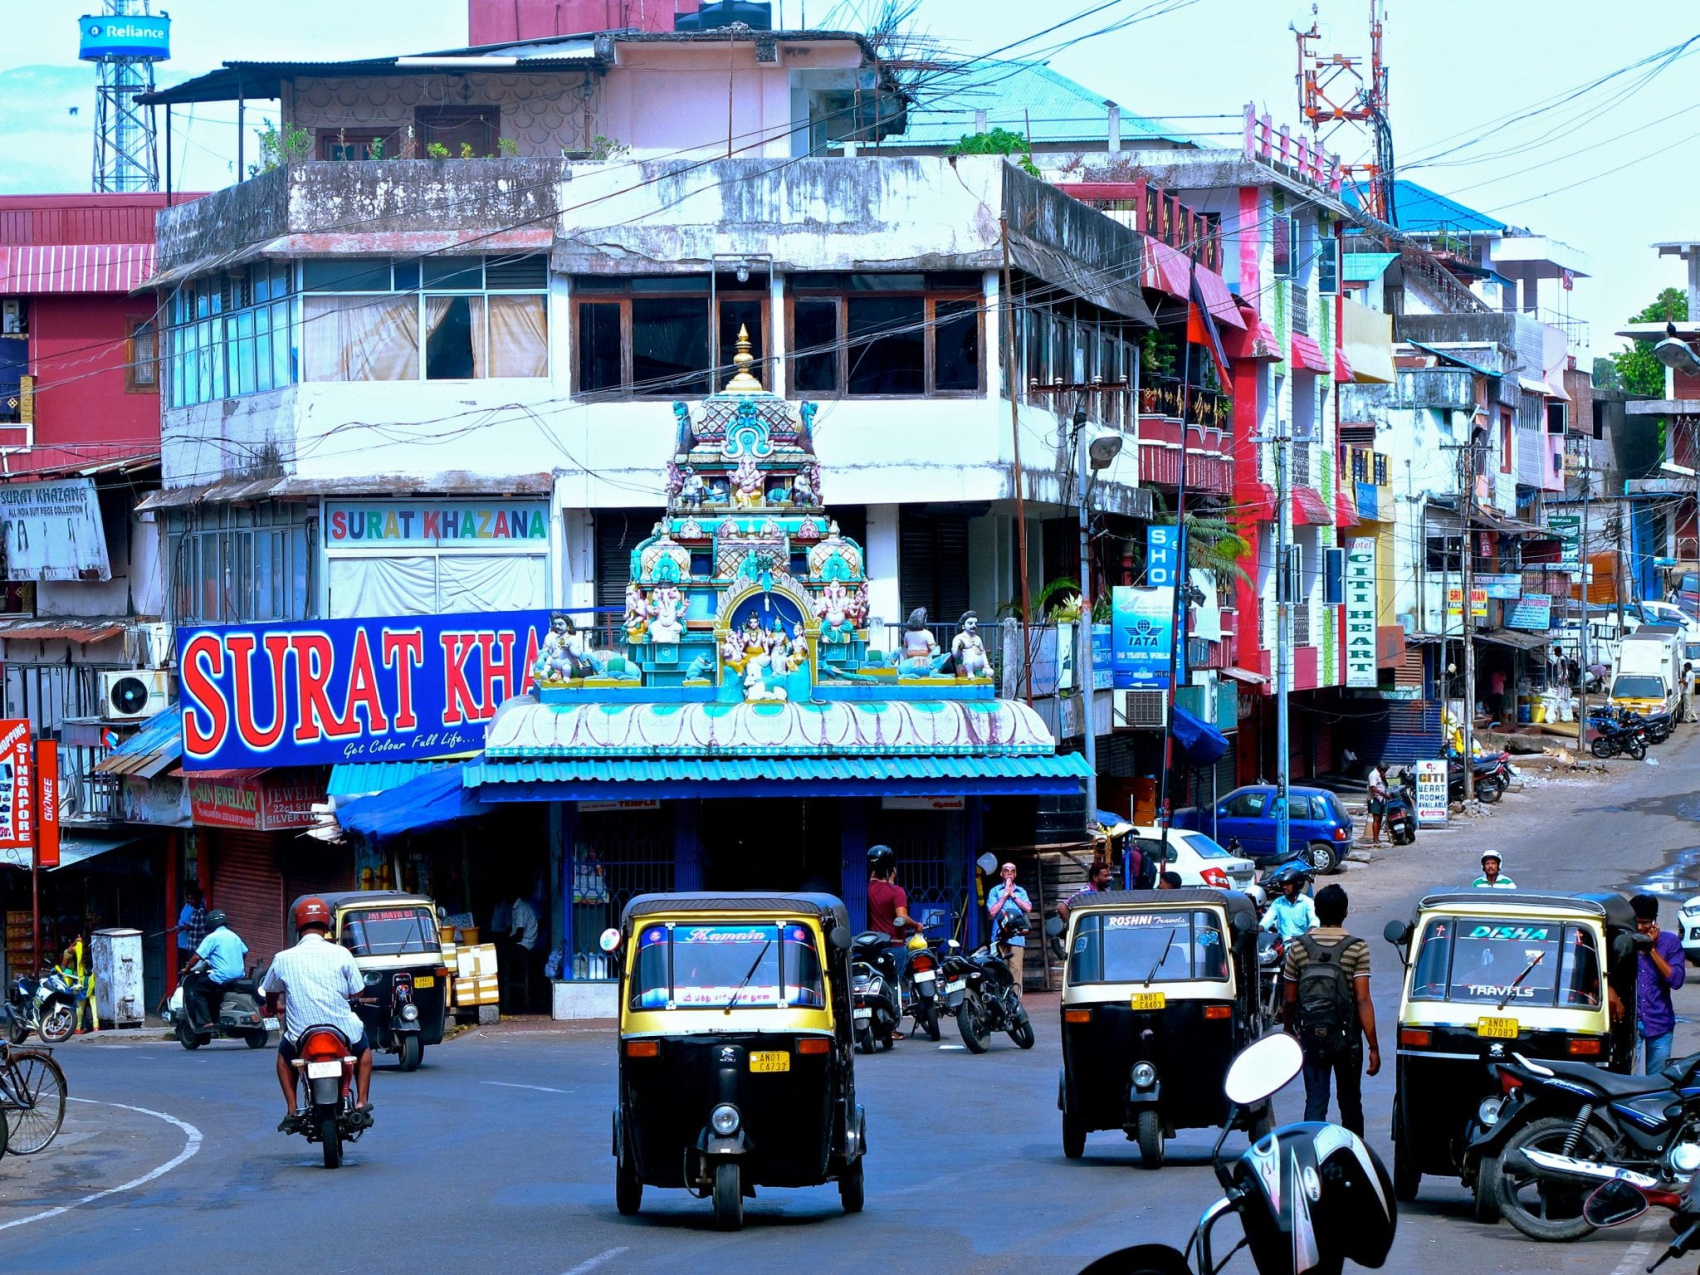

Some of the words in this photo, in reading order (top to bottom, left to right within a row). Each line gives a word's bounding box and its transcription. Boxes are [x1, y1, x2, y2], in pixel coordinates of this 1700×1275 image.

[106, 25, 164, 39] Reliance
[1, 489, 32, 504] SURAT
[36, 487, 87, 503] KHAZANA
[40, 507, 53, 516] PIECE
[54, 505, 83, 515] COLLECTION
[332, 511, 414, 539] SURAT
[423, 510, 546, 539] KHAZANA
[1349, 541, 1372, 549] Hotel
[1348, 554, 1373, 602] CITI
[1450, 590, 1461, 600] SRI
[1129, 637, 1158, 646] IATA
[1348, 611, 1374, 672] HEART
[184, 628, 421, 754] SURAT
[343, 743, 364, 759] Get
[369, 739, 406, 753] Colour
[412, 734, 438, 748] Full
[16, 743, 30, 841] SINGAPORE
[197, 783, 213, 804] SUN
[267, 813, 299, 824] SILVER
[367, 912, 379, 920] JAI
[1109, 915, 1152, 926] ROSHNI
[1153, 916, 1186, 925] Travels
[685, 928, 766, 941] Kamala
[1469, 925, 1548, 940] DISHA
[1468, 985, 1534, 997] TRAVELS
[1488, 1018, 1509, 1027] AN01
[1487, 1028, 1514, 1037] D7083
[760, 1053, 780, 1062] AN01
